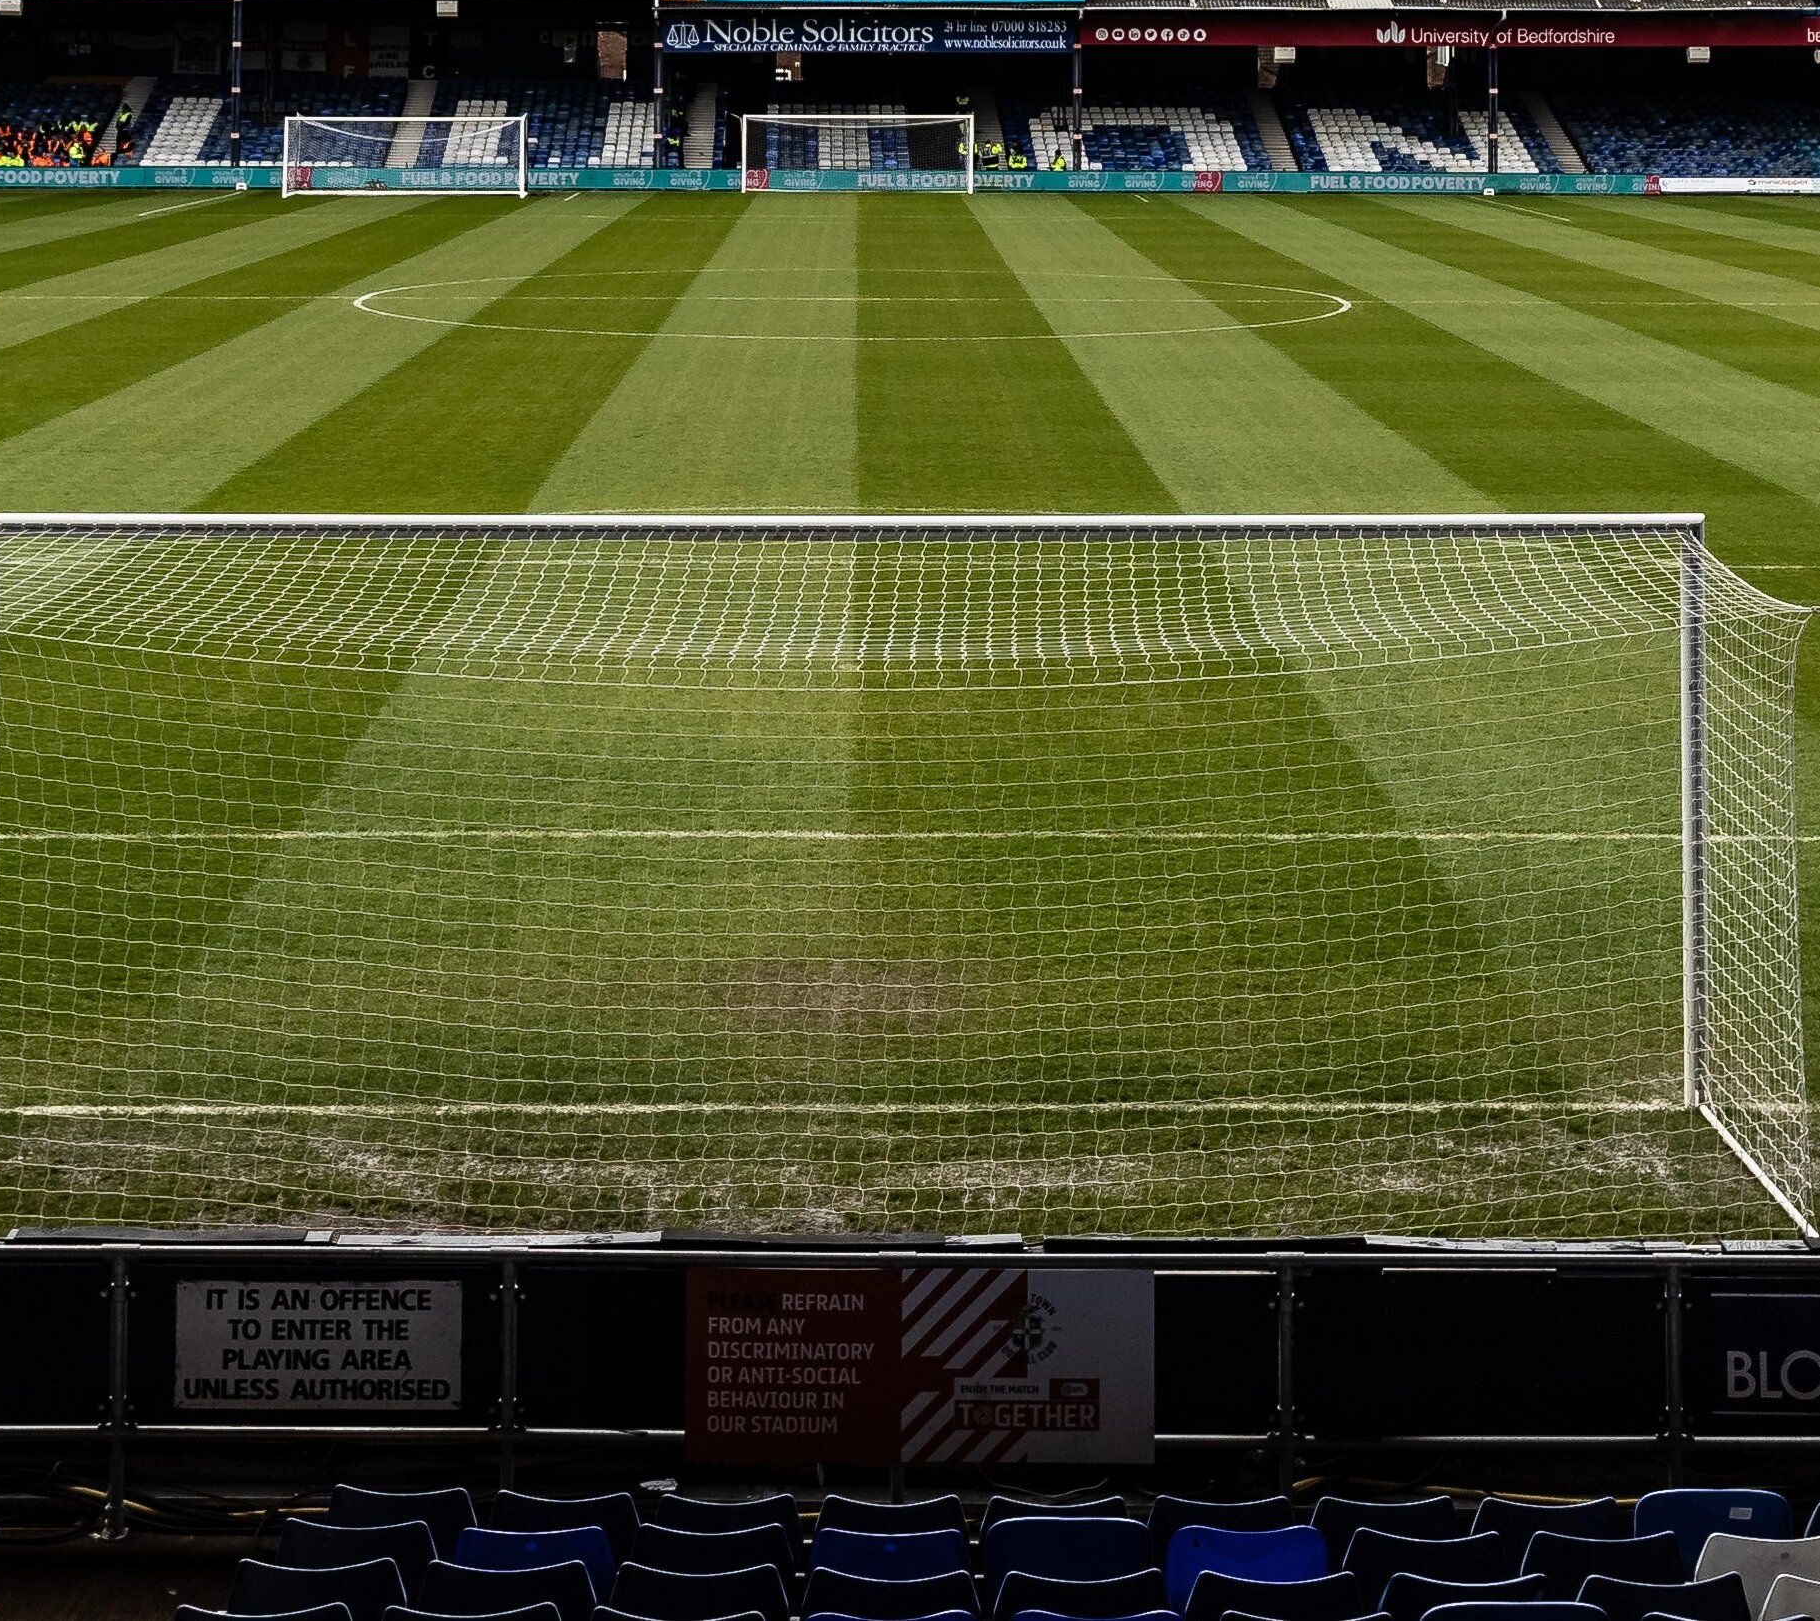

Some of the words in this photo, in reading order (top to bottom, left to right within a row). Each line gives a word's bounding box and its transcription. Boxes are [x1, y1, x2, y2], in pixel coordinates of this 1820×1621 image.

[704, 18, 794, 45] Noble
[802, 18, 934, 44] Solicitors
[956, 21, 967, 32] hr
[970, 21, 988, 32] line
[992, 21, 1024, 32] 07000
[1028, 20, 1067, 32] 818283
[944, 35, 1067, 48] www.noblesolicitors.co.uk
[1411, 27, 1489, 45] University
[1496, 29, 1513, 44] of
[1517, 28, 1614, 44] Bedfordshire
[714, 43, 772, 52] SPECIALIST
[775, 43, 824, 52] CRIMINAL
[838, 43, 875, 52] FAMILY
[878, 43, 925, 52] PRACTICE
[44, 170, 121, 183] POVERTY
[858, 174, 894, 187] FUEL
[911, 174, 959, 187] FOOD
[1310, 176, 1347, 189] FUEL
[1349, 176, 1362, 189] &
[1364, 176, 1414, 189] FOOD
[1417, 176, 1487, 190] POVERTY
[207, 1288, 226, 1312] IT
[235, 1288, 258, 1312] IS
[270, 1288, 309, 1312] AN
[317, 1287, 432, 1312] OFFENCE
[708, 1292, 777, 1311] PLEASE
[782, 1293, 864, 1311] REFRAIN
[1030, 1293, 1058, 1317] TOWN
[228, 1318, 261, 1342] TO
[271, 1318, 353, 1342] ENTER
[364, 1318, 409, 1342] THE
[708, 1317, 761, 1335] FROM
[767, 1317, 804, 1335] ANY
[708, 1342, 874, 1360] DISCRIMINATORY
[1037, 1340, 1059, 1362] CLUB
[223, 1348, 326, 1373] PLAYING
[340, 1349, 412, 1373] AREA
[708, 1367, 732, 1384] OR
[737, 1367, 861, 1385] ANTI-SOCIAL
[184, 1378, 281, 1402] UNLESS
[292, 1378, 451, 1403] AUTHORISED
[960, 1384, 988, 1395] ENJOY
[990, 1384, 1007, 1395] THE
[1009, 1384, 1039, 1395] MATCH
[708, 1392, 818, 1409] BEHAVIOUR
[822, 1392, 844, 1409] IN
[708, 1415, 746, 1433] OUR
[751, 1415, 837, 1433] STADIUM
